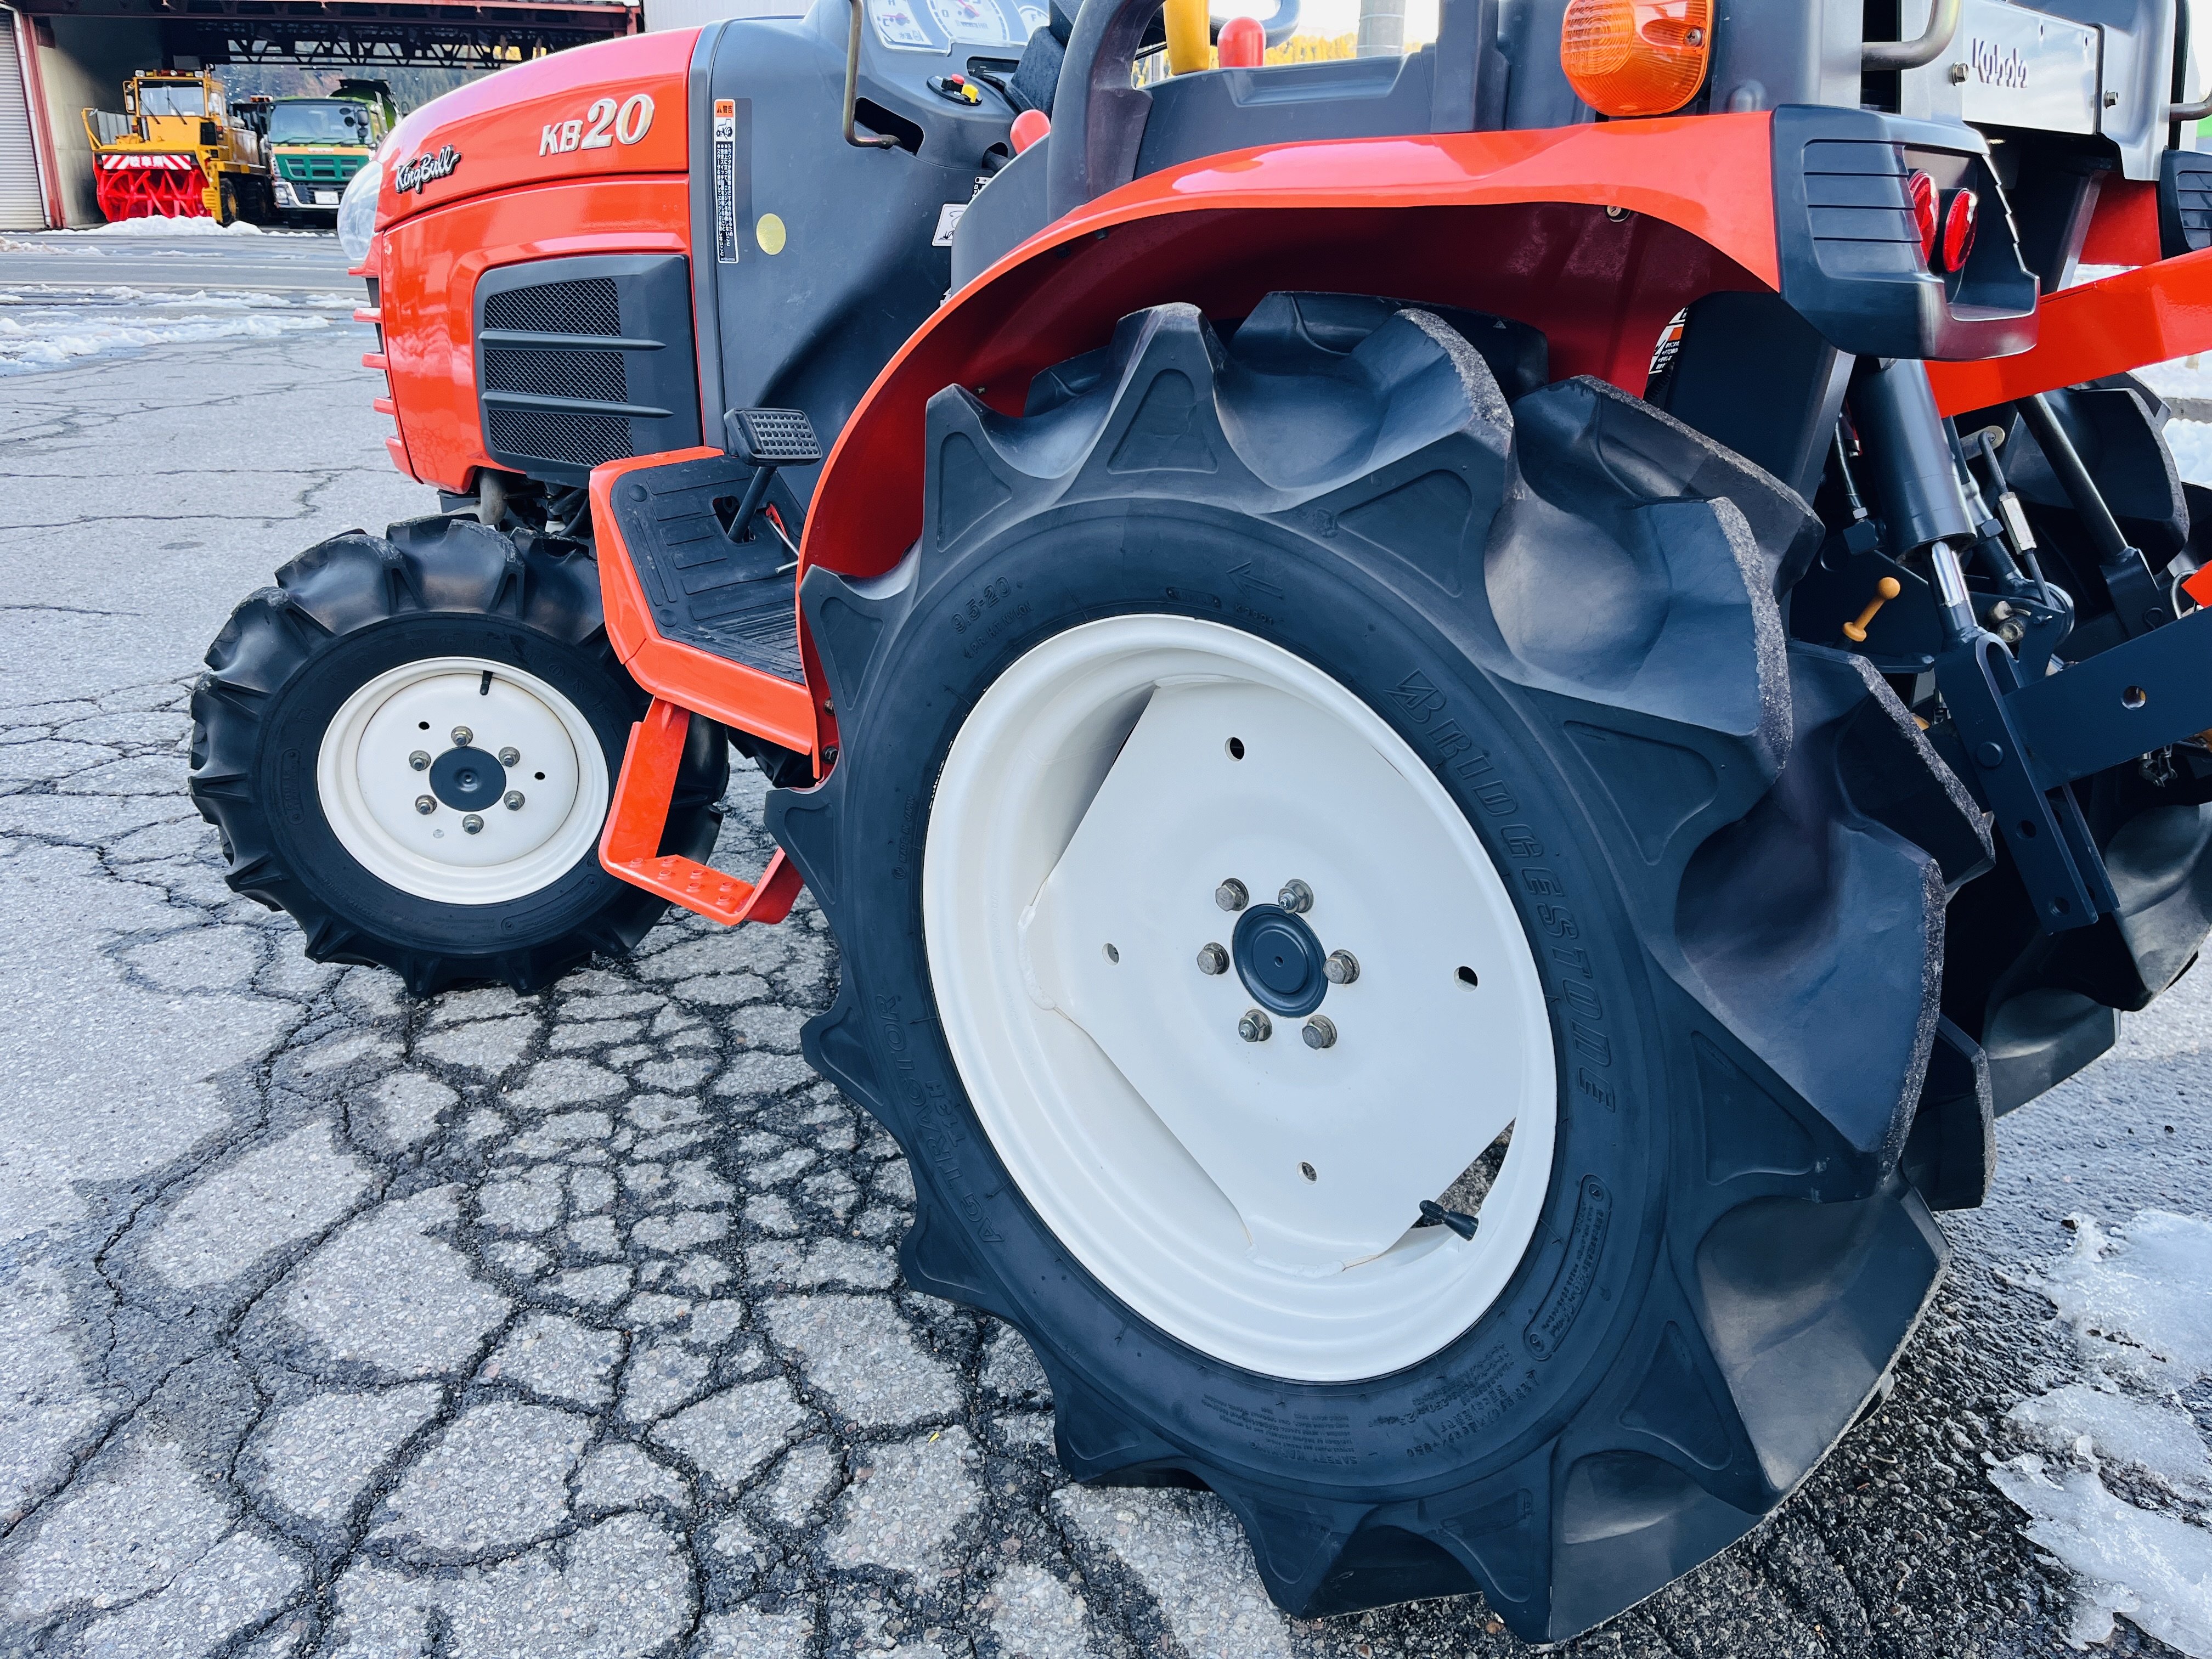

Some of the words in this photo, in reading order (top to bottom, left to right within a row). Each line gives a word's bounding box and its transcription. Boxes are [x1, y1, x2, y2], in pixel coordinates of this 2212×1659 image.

[1972, 37, 2029, 88] Kubota
[538, 93, 655, 156] KB20
[723, 105, 733, 114] 警告
[951, 577, 1012, 634] 9.5-20
[901, 825, 910, 835] IN
[904, 794, 916, 821] JAPAN
[899, 836, 909, 864] MADE
[1384, 669, 1616, 1113] BRIDGESTONE
[876, 994, 963, 1189] TRACTOR
